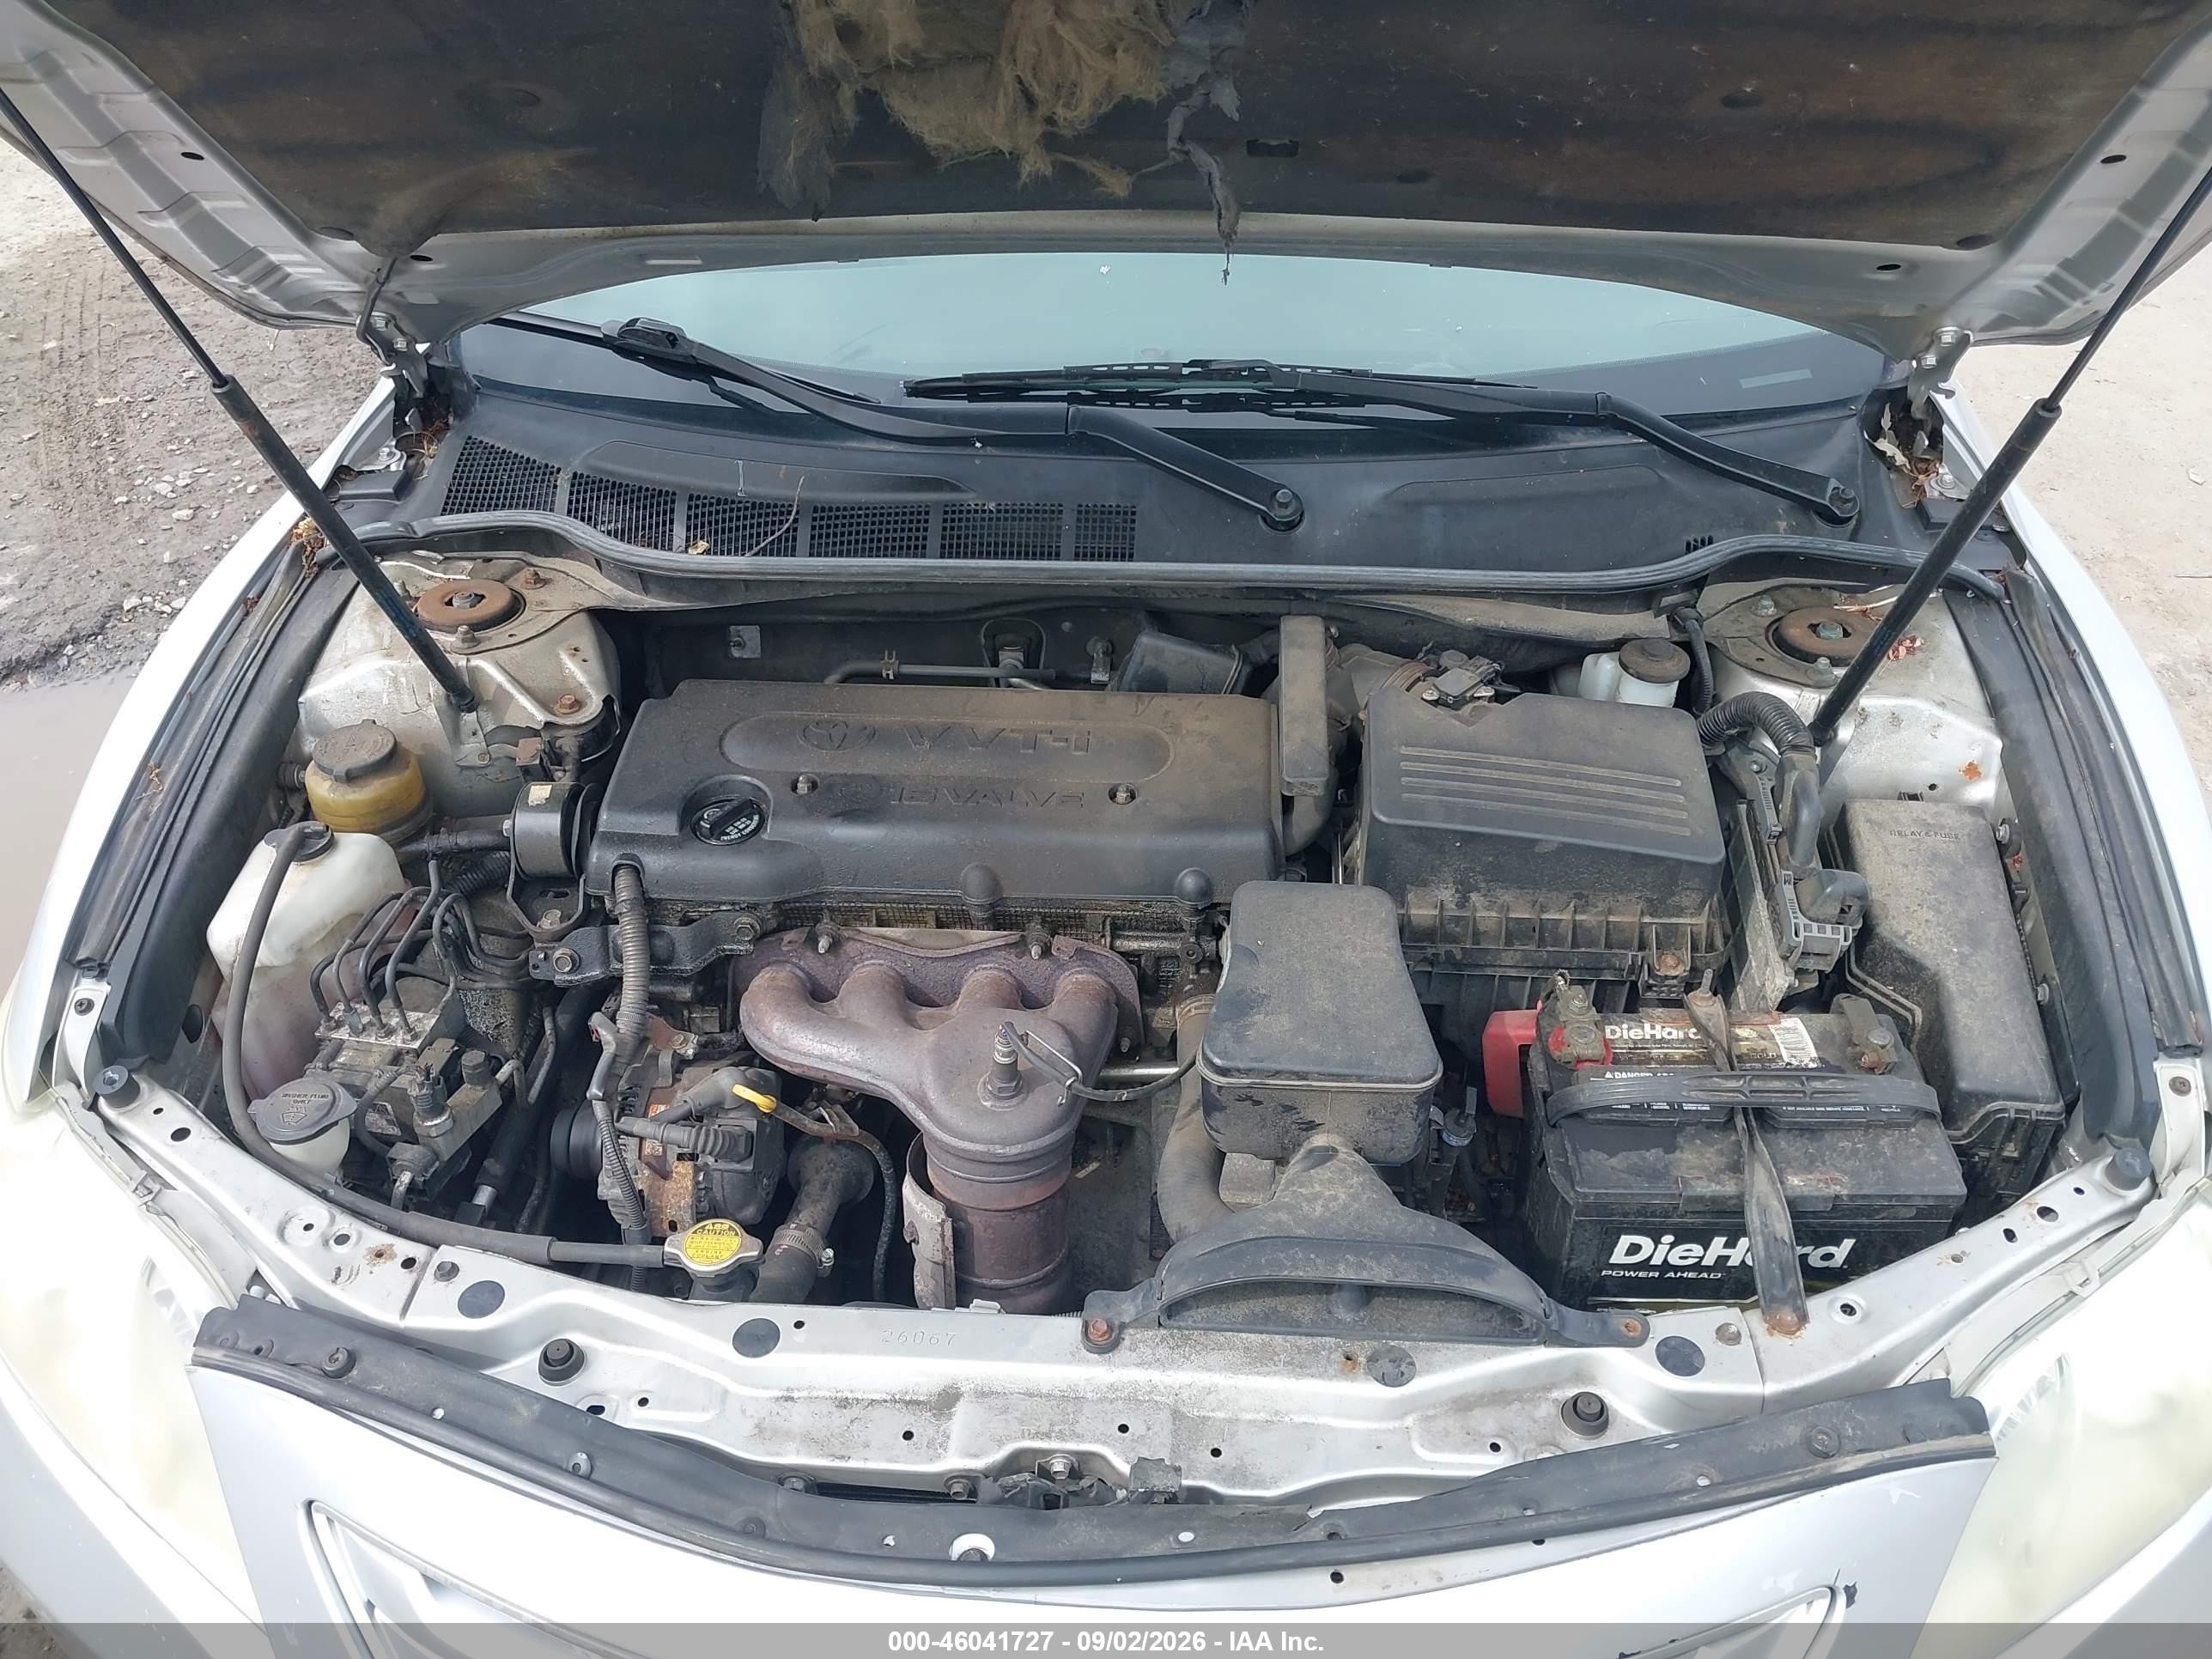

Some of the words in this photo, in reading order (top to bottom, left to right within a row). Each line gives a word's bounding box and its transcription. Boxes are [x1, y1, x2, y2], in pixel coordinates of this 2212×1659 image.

[1608, 1234, 1856, 1269] DieHrd
[1601, 1269, 1659, 1279] POWER
[1663, 1271, 1723, 1279] AHEAD
